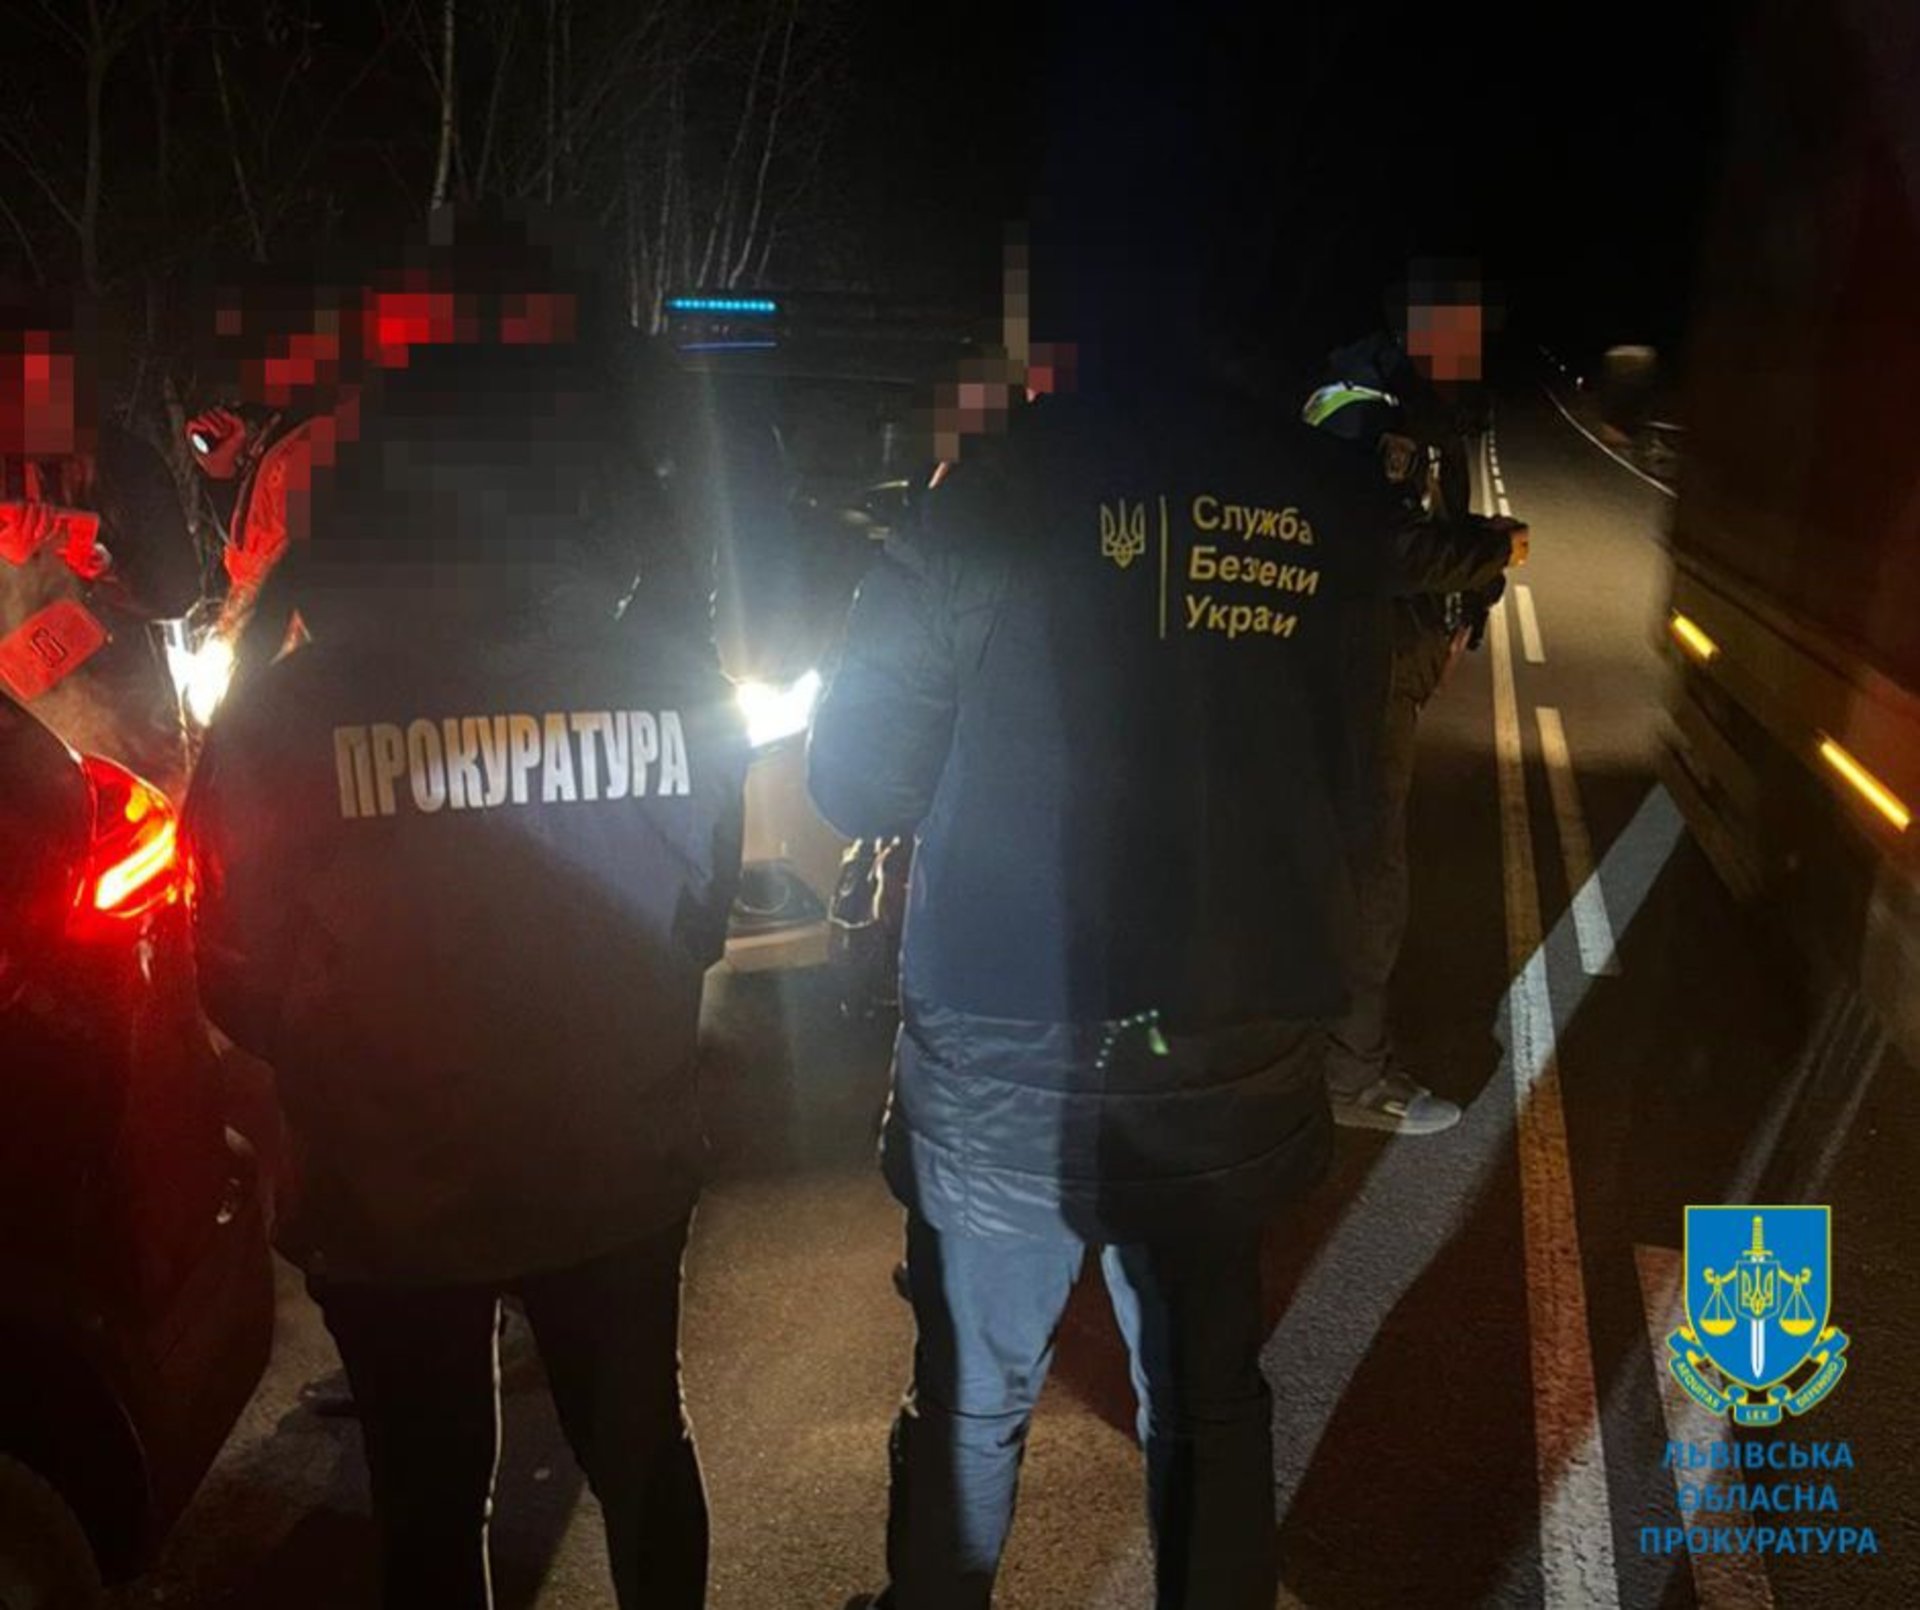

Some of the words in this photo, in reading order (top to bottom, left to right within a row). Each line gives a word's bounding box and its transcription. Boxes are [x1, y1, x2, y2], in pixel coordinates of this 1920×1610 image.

[1192, 495, 1314, 545] Служба
[1189, 545, 1320, 595] Безеки
[333, 710, 691, 818] ПРОКУРАТУРА
